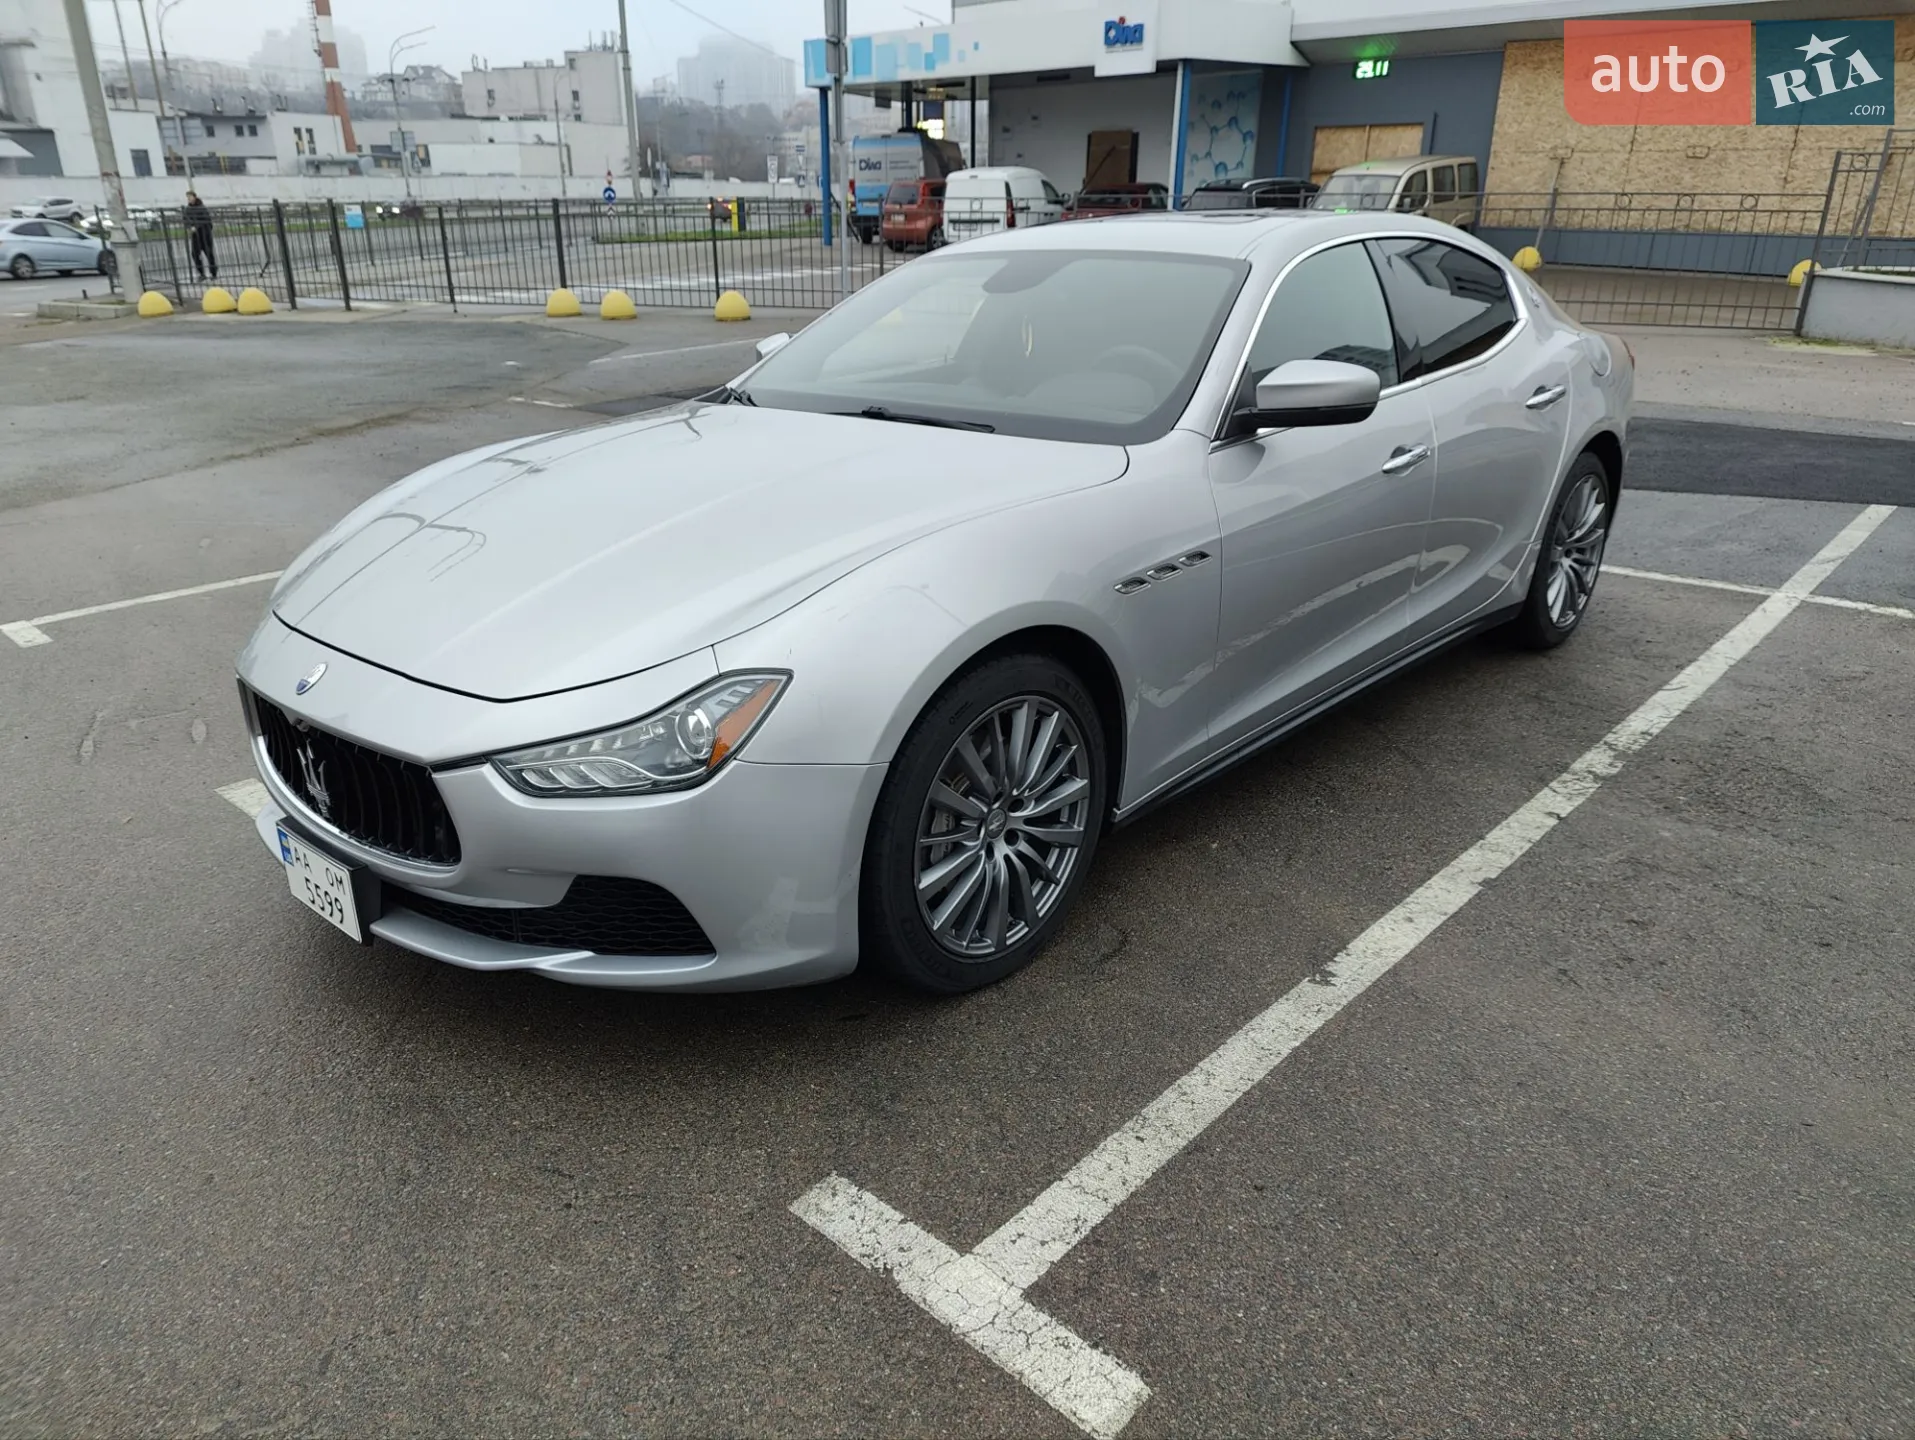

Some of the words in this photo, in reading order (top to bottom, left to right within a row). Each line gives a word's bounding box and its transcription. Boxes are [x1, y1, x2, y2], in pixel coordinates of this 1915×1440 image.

[294, 846, 313, 874] AA
[325, 867, 346, 895] OM
[304, 876, 344, 925] 5599
